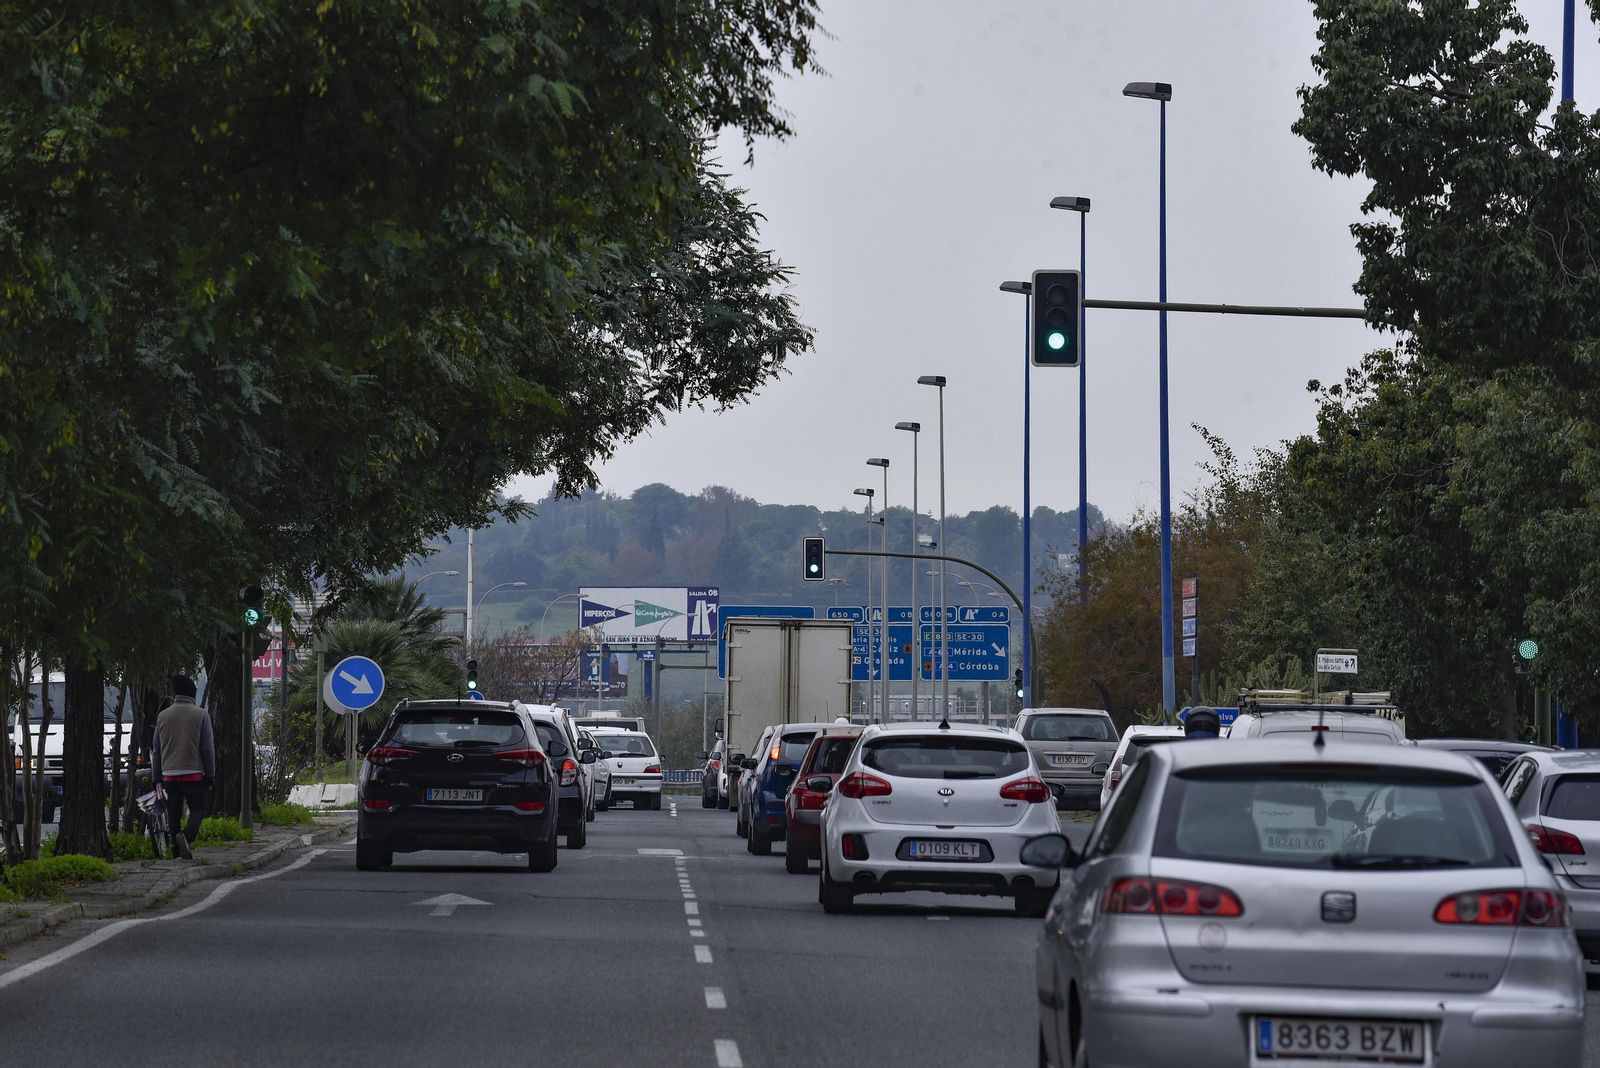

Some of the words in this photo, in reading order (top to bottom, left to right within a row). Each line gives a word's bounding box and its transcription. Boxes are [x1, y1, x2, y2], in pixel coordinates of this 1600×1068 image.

[831, 611, 848, 619] 650
[954, 647, 987, 656] Mérida
[959, 662, 1000, 670] Córdoba
[1218, 712, 1234, 721] elva
[434, 790, 459, 800] 7113
[462, 790, 481, 800] JNT
[1275, 837, 1301, 848] 8249
[1304, 838, 1325, 849] KXG
[918, 844, 950, 854] 0109
[953, 844, 977, 855] KLT
[1277, 1023, 1350, 1051] 8363
[1360, 1026, 1414, 1052] BZW
